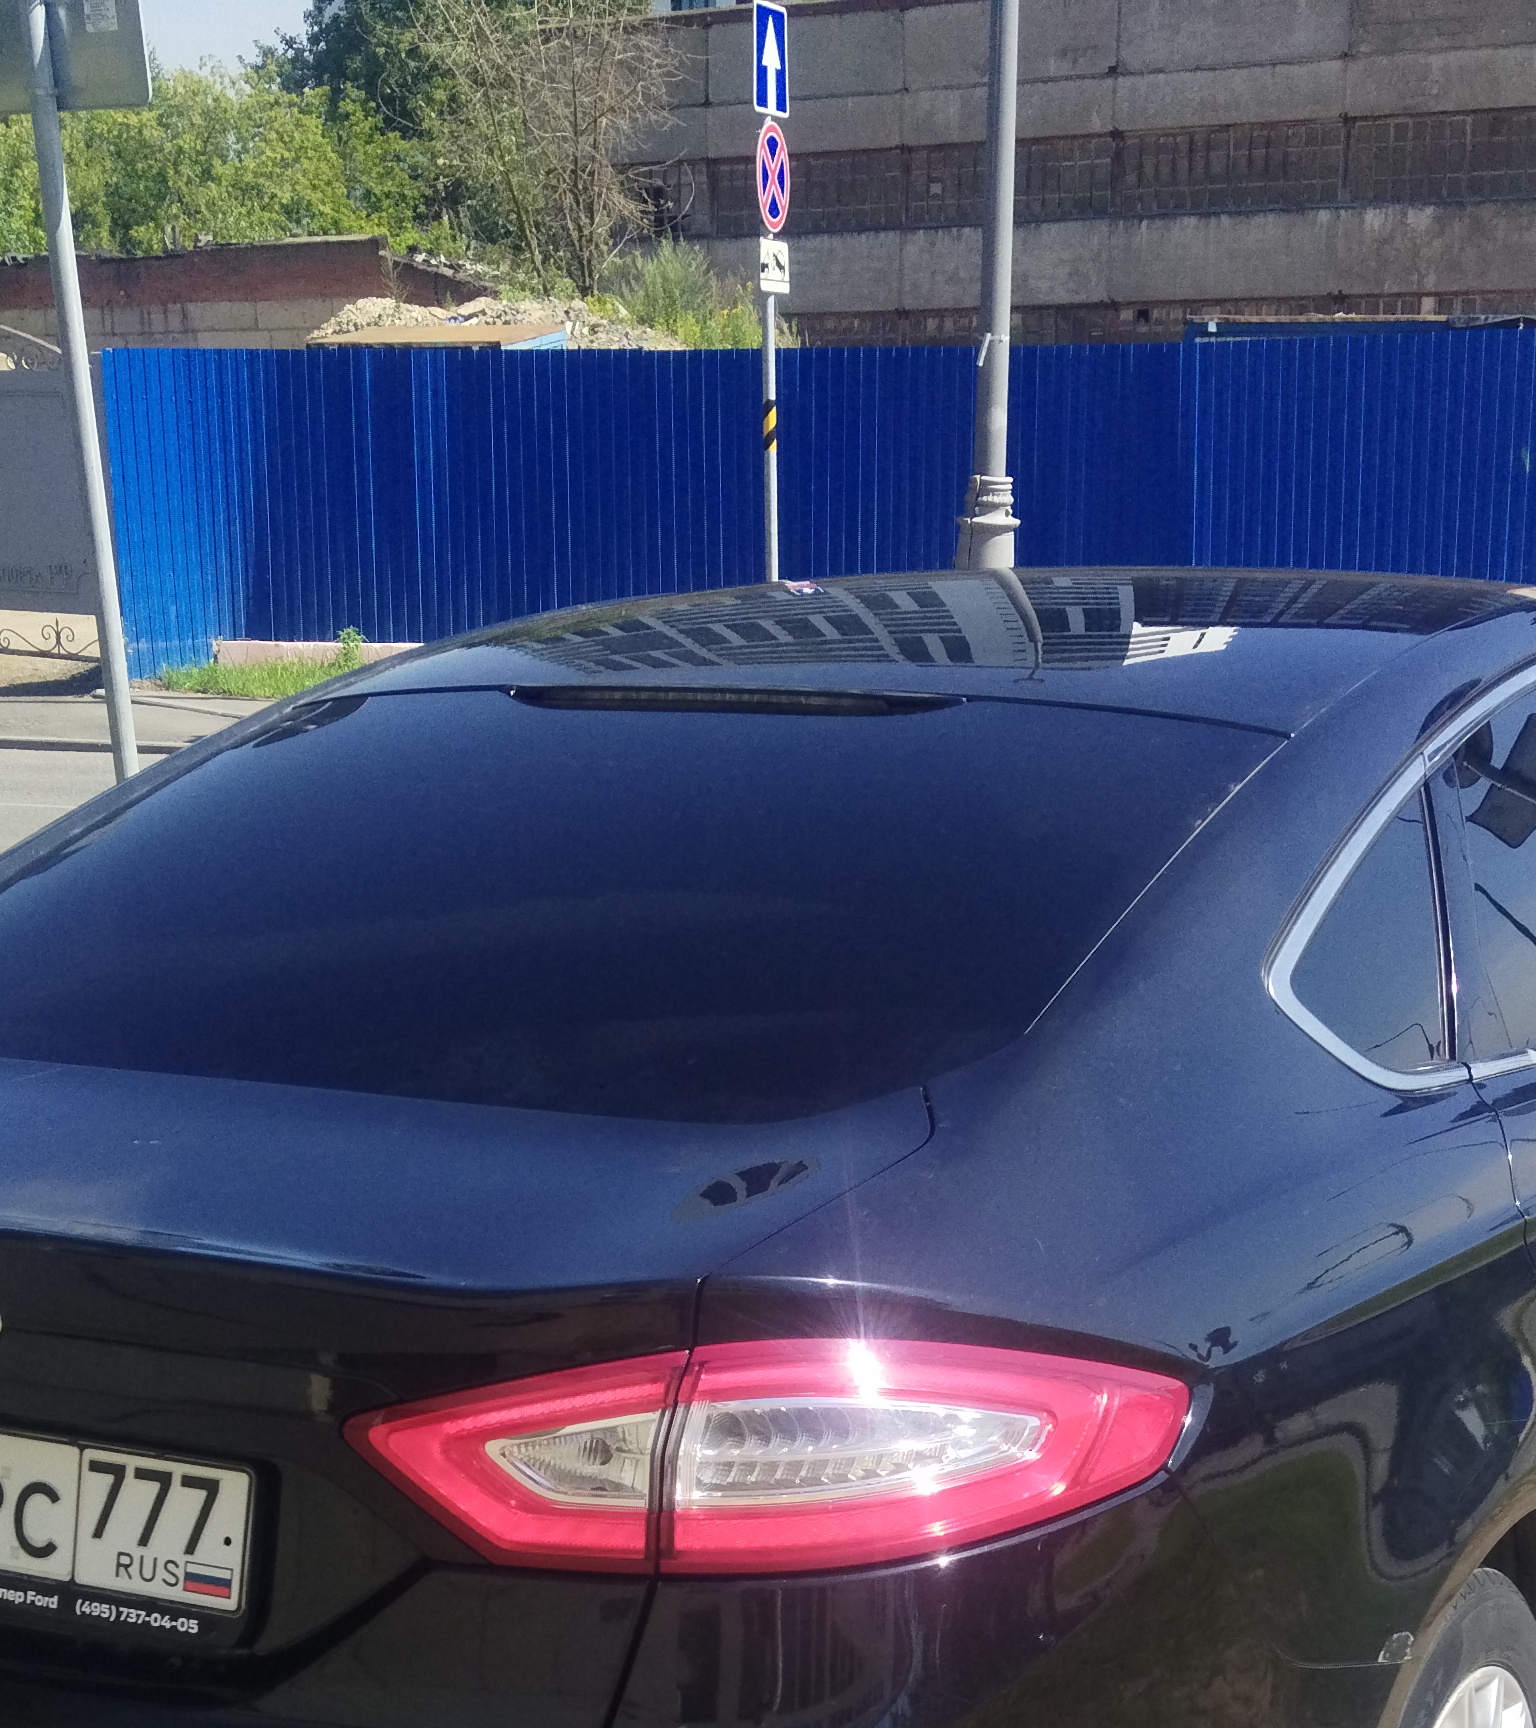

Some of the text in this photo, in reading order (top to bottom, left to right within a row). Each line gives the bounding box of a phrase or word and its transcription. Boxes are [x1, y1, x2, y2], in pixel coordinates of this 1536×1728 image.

[86, 1460, 224, 1556] 777
[115, 1551, 180, 1588] RUS
[26, 1590, 59, 1609] Ford
[75, 1599, 117, 1622] (495)
[118, 1607, 199, 1634] 737-04-05
